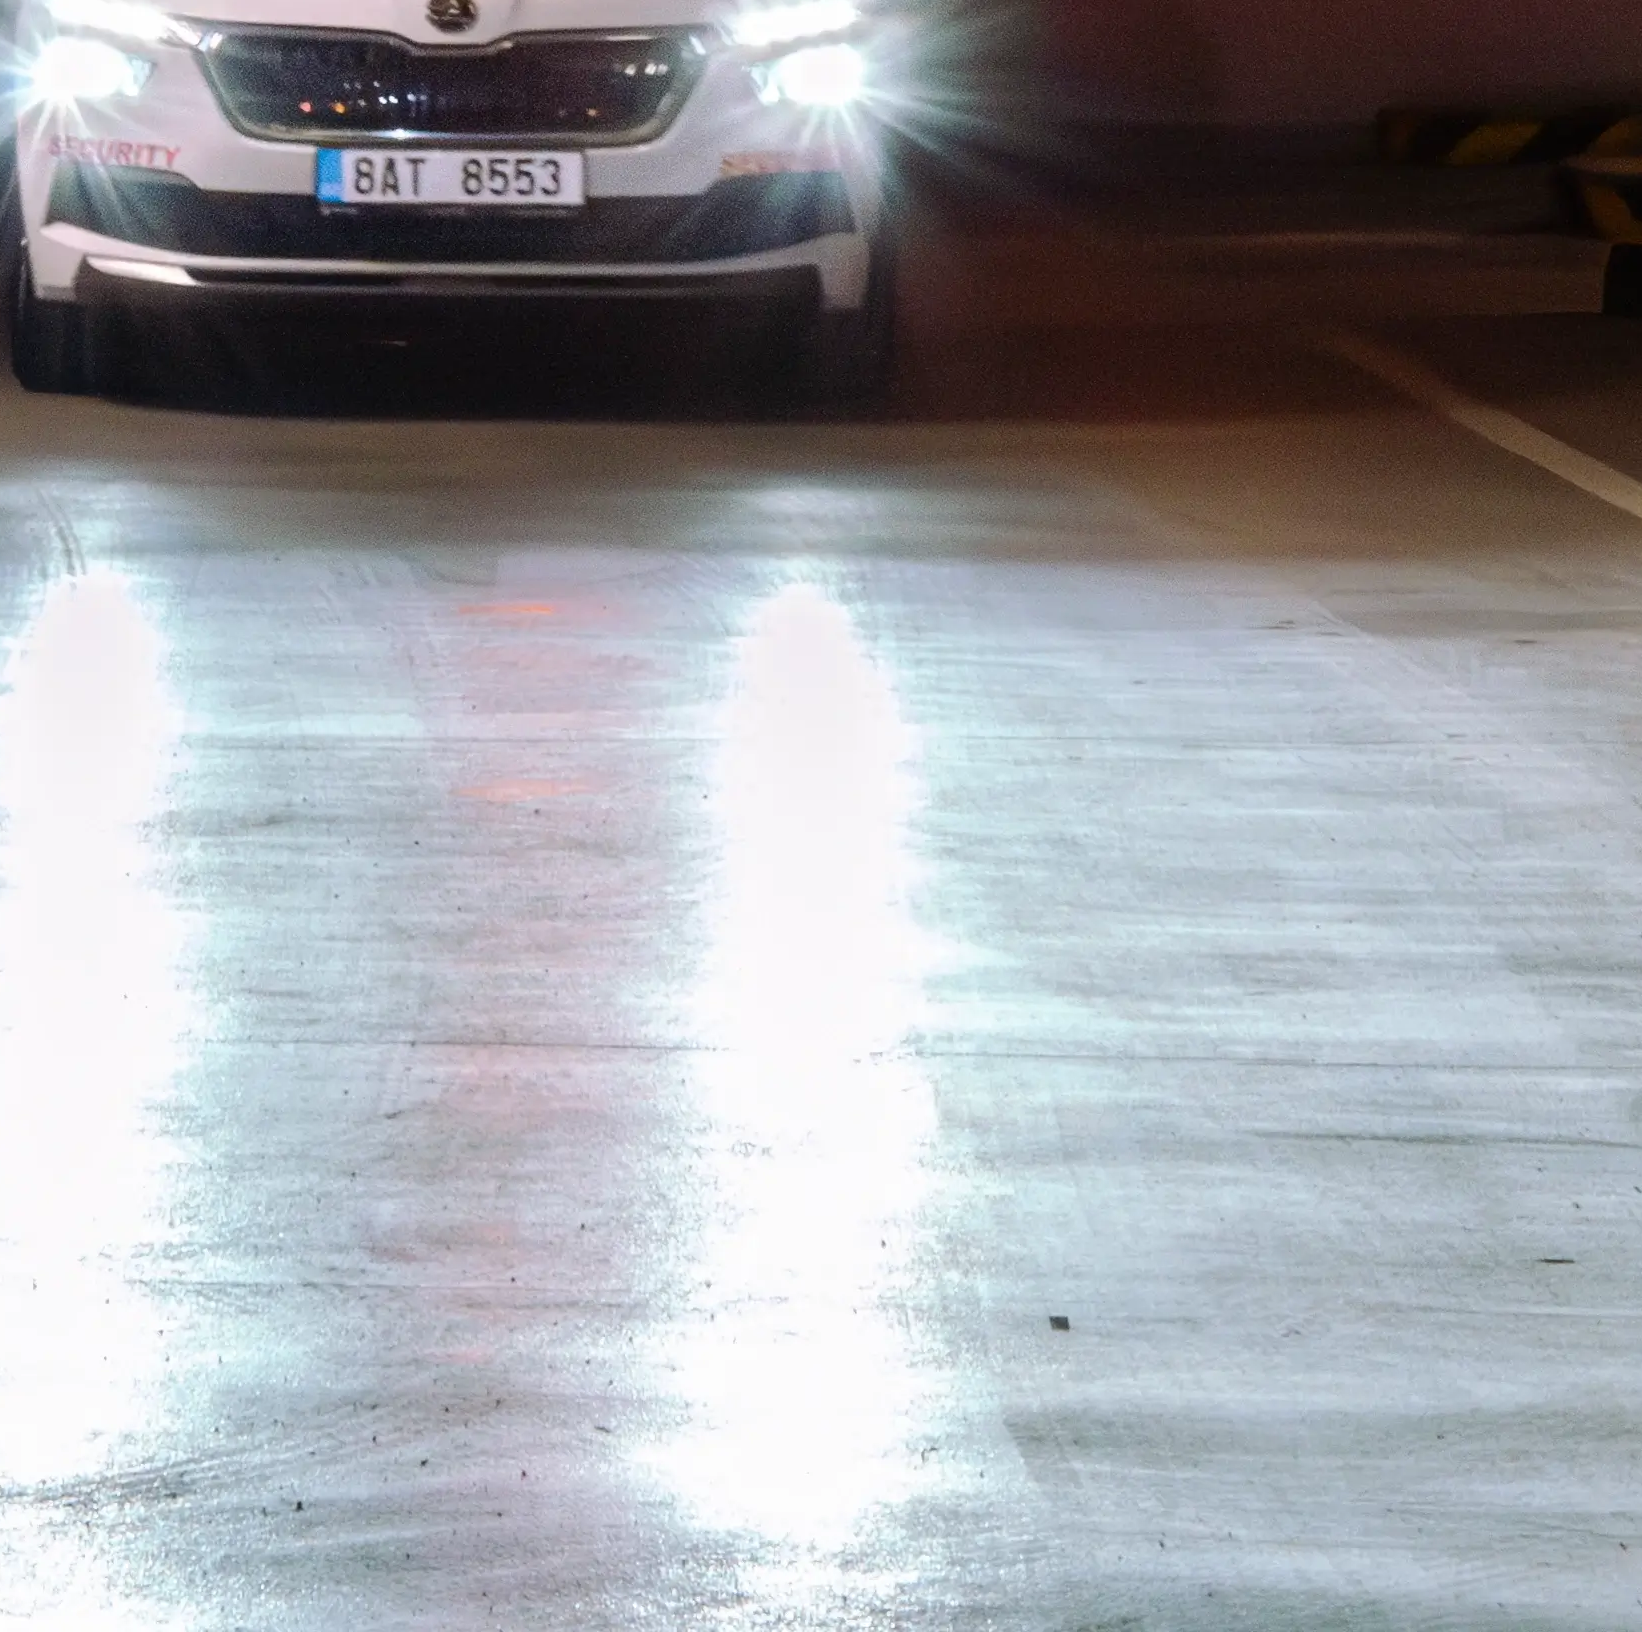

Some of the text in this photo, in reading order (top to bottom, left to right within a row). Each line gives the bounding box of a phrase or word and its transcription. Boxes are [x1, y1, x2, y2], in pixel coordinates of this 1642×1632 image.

[48, 134, 182, 167] SECURITY
[353, 156, 563, 198] 8AT 8553
